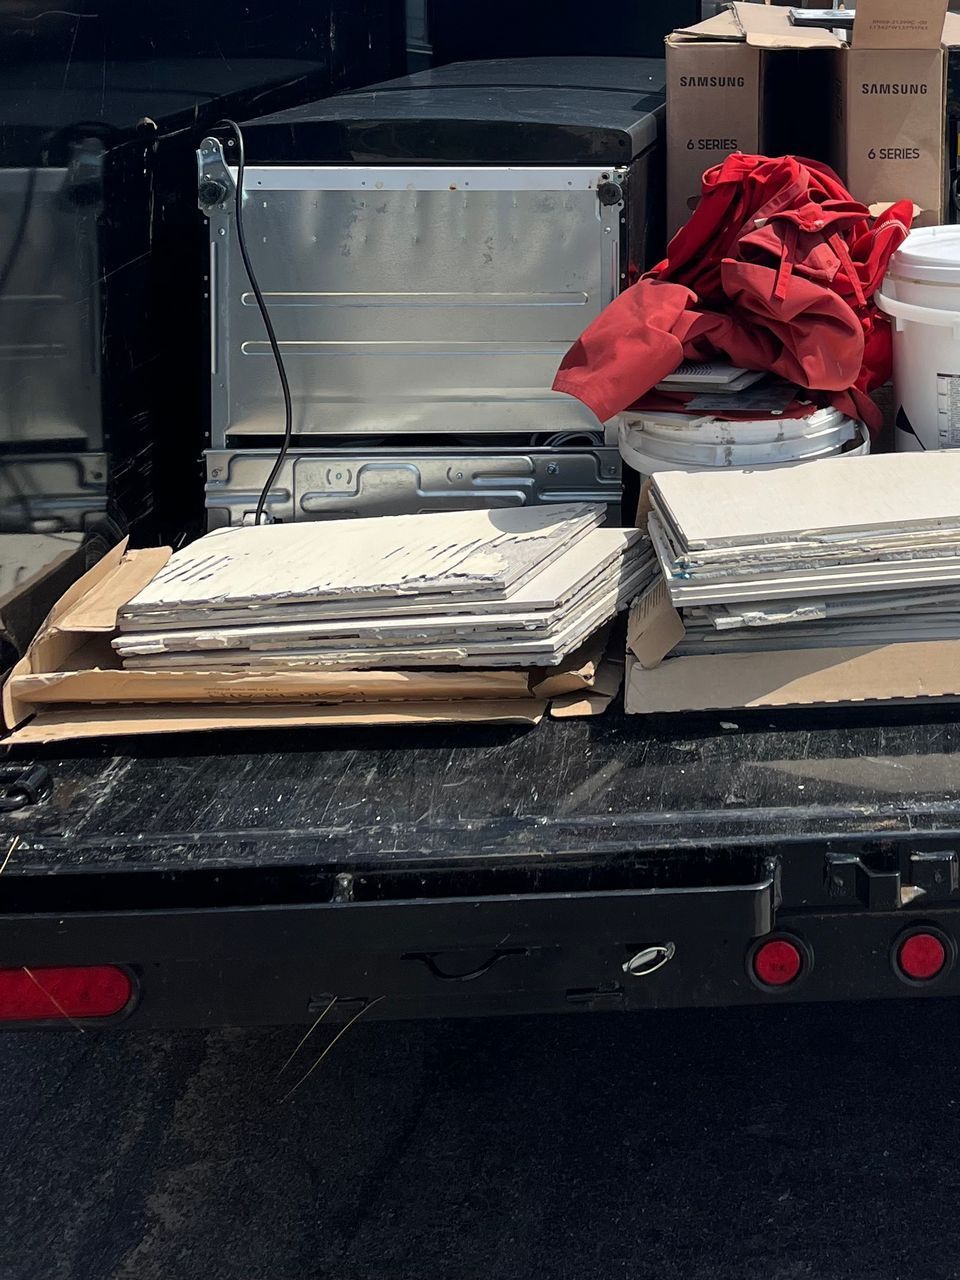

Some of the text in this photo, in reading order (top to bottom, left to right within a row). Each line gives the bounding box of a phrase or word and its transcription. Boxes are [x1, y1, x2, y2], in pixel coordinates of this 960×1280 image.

[679, 76, 745, 87] SAMSUNG
[861, 83, 928, 95] SAMSUNG
[686, 139, 738, 150] 6 SERIES
[867, 148, 920, 160] 6 SERIES
